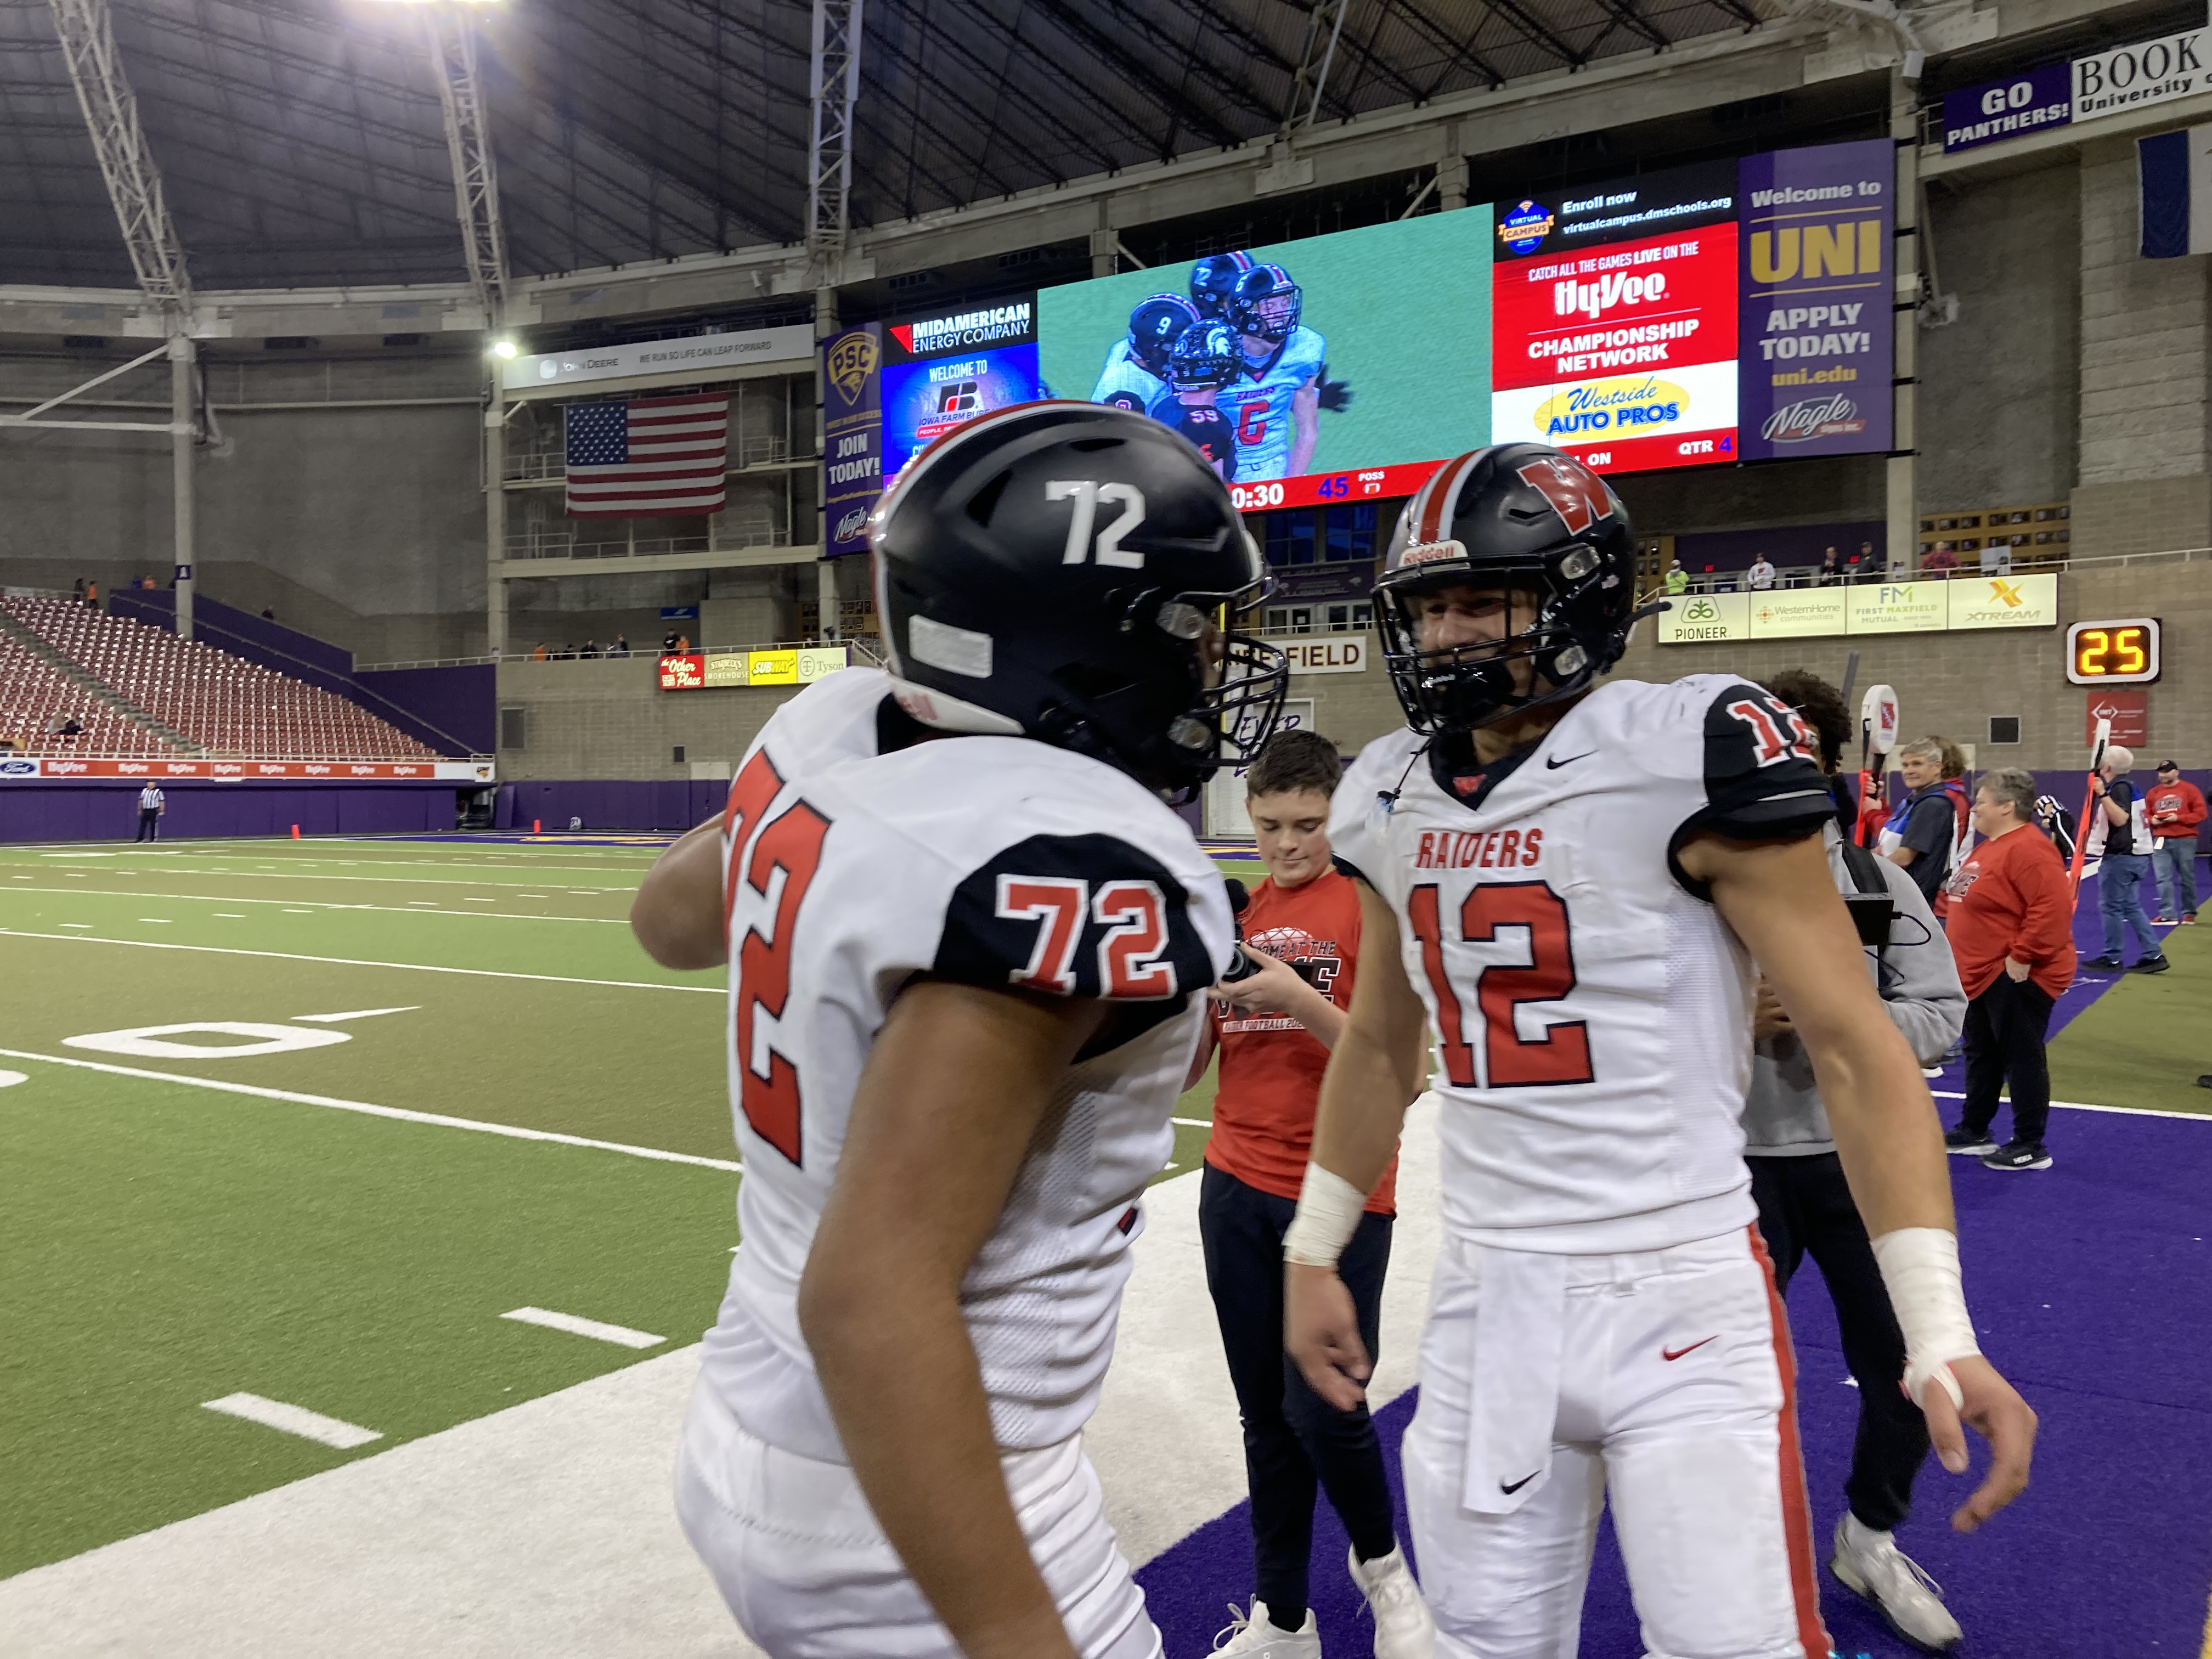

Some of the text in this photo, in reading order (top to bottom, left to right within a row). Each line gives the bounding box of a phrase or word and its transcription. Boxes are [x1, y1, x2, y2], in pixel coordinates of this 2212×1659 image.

[2078, 35, 2203, 98] BOOK
[1981, 82, 2033, 115] GO
[2081, 77, 2193, 114] University
[1946, 103, 2069, 146] PANTHERS!
[1562, 190, 1637, 214] Enroll now
[1751, 180, 1882, 208] Welcome to
[1510, 214, 1543, 225] VIRTUAL
[1562, 196, 1731, 235] virtualcampus.dmschools.org
[1506, 224, 1547, 238] CAMPUS
[1528, 241, 1699, 281] CATCH ALL THE GAMES LIVE ON THE
[1750, 220, 1881, 284] UNI
[912, 303, 1030, 339] MIDAMERICAN
[1156, 317, 1172, 335] 9
[1766, 302, 1864, 332] APPLY
[912, 319, 1030, 354] ENERGY COMPANY
[1528, 318, 1700, 359] CHAMPIONSHIP
[1759, 331, 1871, 360] TODAY!
[587, 358, 619, 369] DEERE
[640, 354, 651, 363] WE
[669, 351, 679, 359] SO
[680, 349, 696, 359] LIFE
[697, 348, 713, 357] CAN
[714, 345, 733, 355] LEAP
[734, 341, 772, 353] FORWARD
[833, 344, 871, 378] PSC
[1557, 342, 1669, 374] NETWORK
[929, 359, 988, 382] WELCOME TO
[1771, 364, 1857, 387] uni.edu
[1567, 376, 1659, 411] Westside
[918, 417, 939, 426] IOWA
[941, 412, 964, 423] FARM
[1546, 401, 1680, 436] AUTO PROS
[1763, 392, 1850, 440] Nagle
[837, 433, 868, 459] JOIN
[1588, 452, 1612, 466] ON
[1679, 436, 1732, 455] QTR 4
[828, 457, 881, 485] TODAY!
[1317, 476, 1350, 499] 45
[1358, 471, 1385, 482] POSS
[834, 506, 867, 542] Nagle
[1045, 480, 1146, 570] 72
[1880, 585, 1913, 603] FM
[1774, 604, 1841, 615] WesternHome
[1780, 613, 1834, 623] communities
[1861, 615, 1899, 624] MUTUAL
[1886, 605, 1938, 614] MAXFIELD
[1965, 610, 2041, 622] XTREAM
[1674, 626, 1727, 640] PIONEER
[1286, 644, 1360, 668] FIELD
[2081, 629, 2143, 673] 25
[669, 658, 696, 673] Other
[676, 672, 702, 687] Place
[704, 670, 749, 680] SMOKEHOUSE
[752, 657, 795, 676] SUBWAY
[816, 661, 844, 673] Tyson
[1726, 697, 1817, 768] 12
[1414, 828, 1543, 870] RAIDERS
[995, 873, 1177, 1001] 72
[1288, 941, 1306, 955] AT
[1309, 940, 1337, 955] THE
[1408, 879, 1595, 1090] 12
[1245, 1019, 1284, 1030] FOOTBALL
